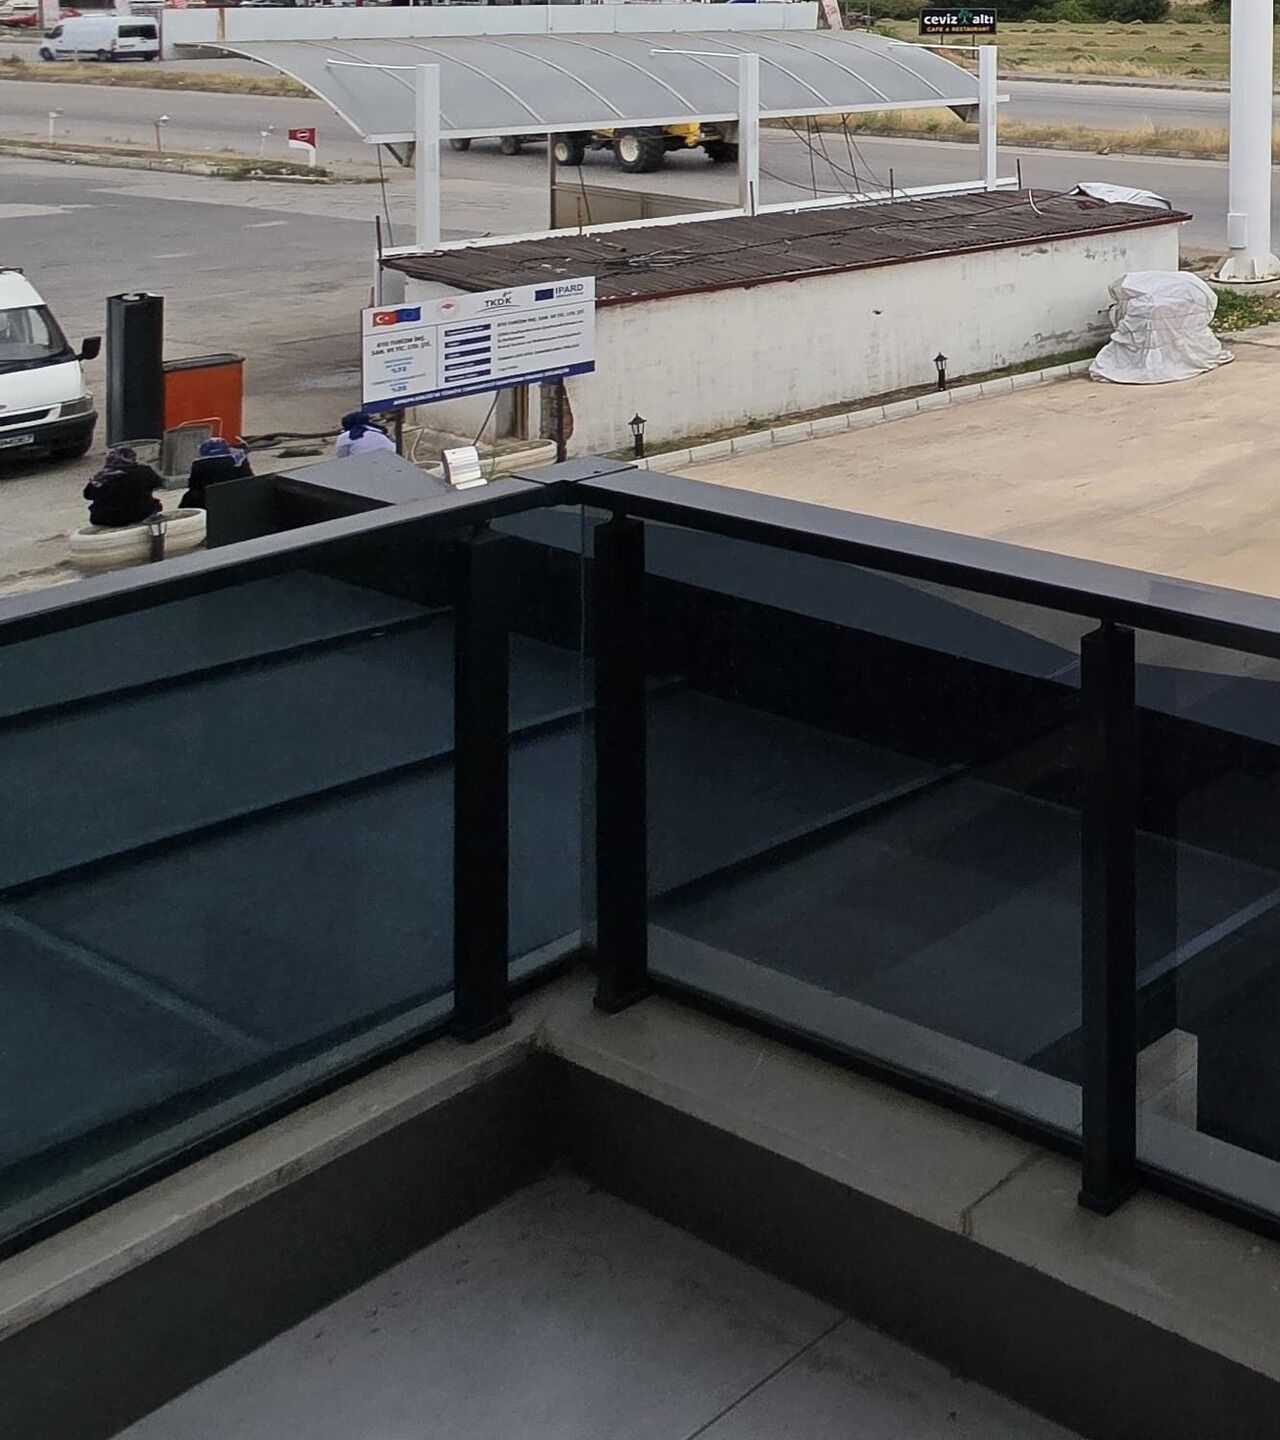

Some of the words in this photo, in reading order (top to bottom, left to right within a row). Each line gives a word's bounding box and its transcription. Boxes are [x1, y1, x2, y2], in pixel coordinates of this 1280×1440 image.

[924, 13, 958, 25] ceviz
[555, 283, 584, 295] IPARD
[484, 297, 512, 308] TKDK
